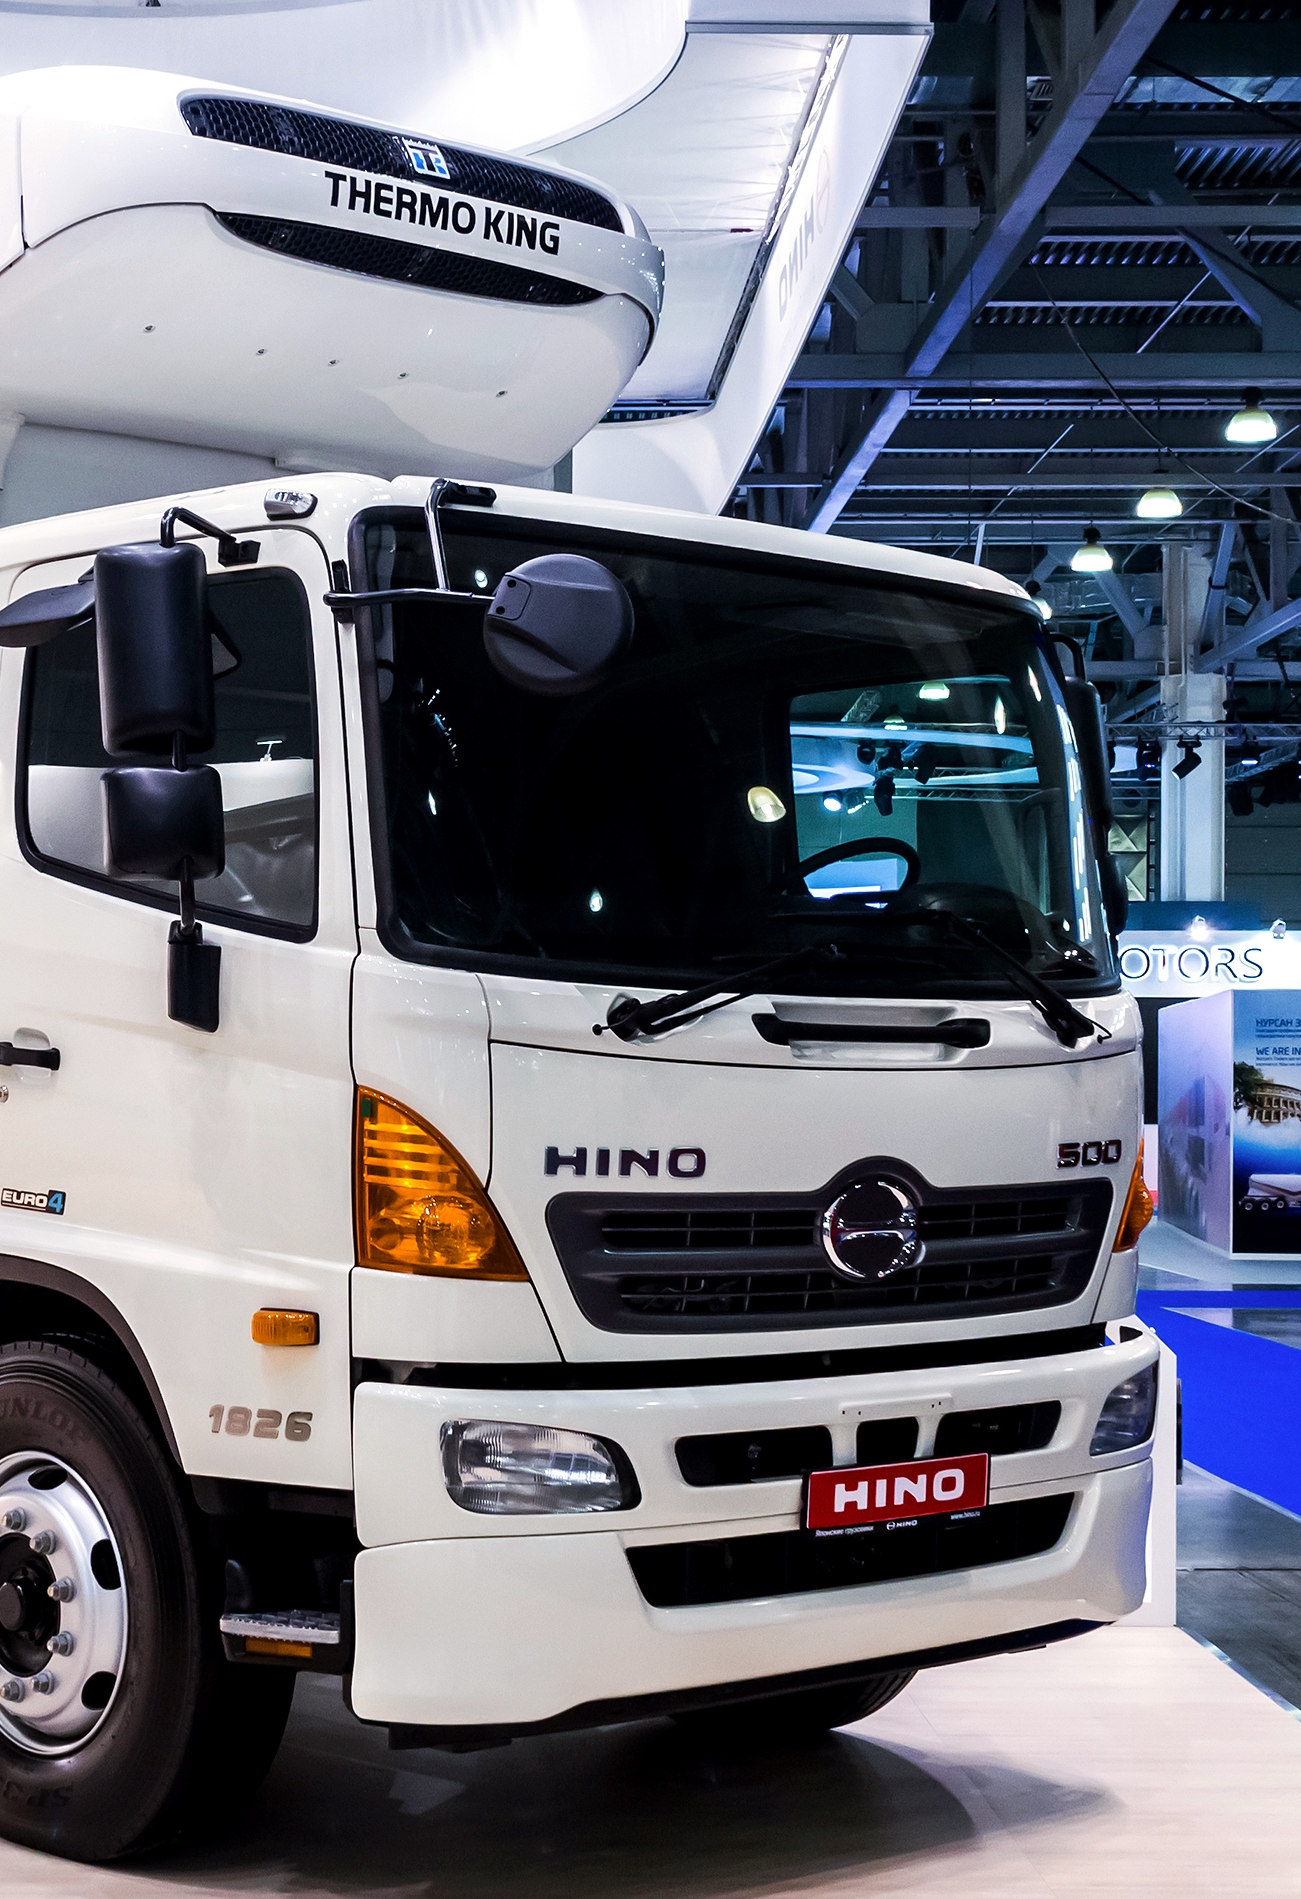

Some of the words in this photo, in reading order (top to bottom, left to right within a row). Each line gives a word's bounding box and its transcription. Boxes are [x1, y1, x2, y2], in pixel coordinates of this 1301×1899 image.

[324, 170, 476, 235] THERMO
[483, 206, 560, 256] KING
[1119, 946, 1263, 980] OTORS
[1255, 1046, 1270, 1056] WE
[1272, 1046, 1290, 1056] ARE
[544, 1145, 708, 1180] HINO
[1056, 1138, 1123, 1169] 500
[208, 1404, 314, 1442] 1826
[833, 1467, 965, 1513] HINO
[896, 1519, 918, 1528] HINO
